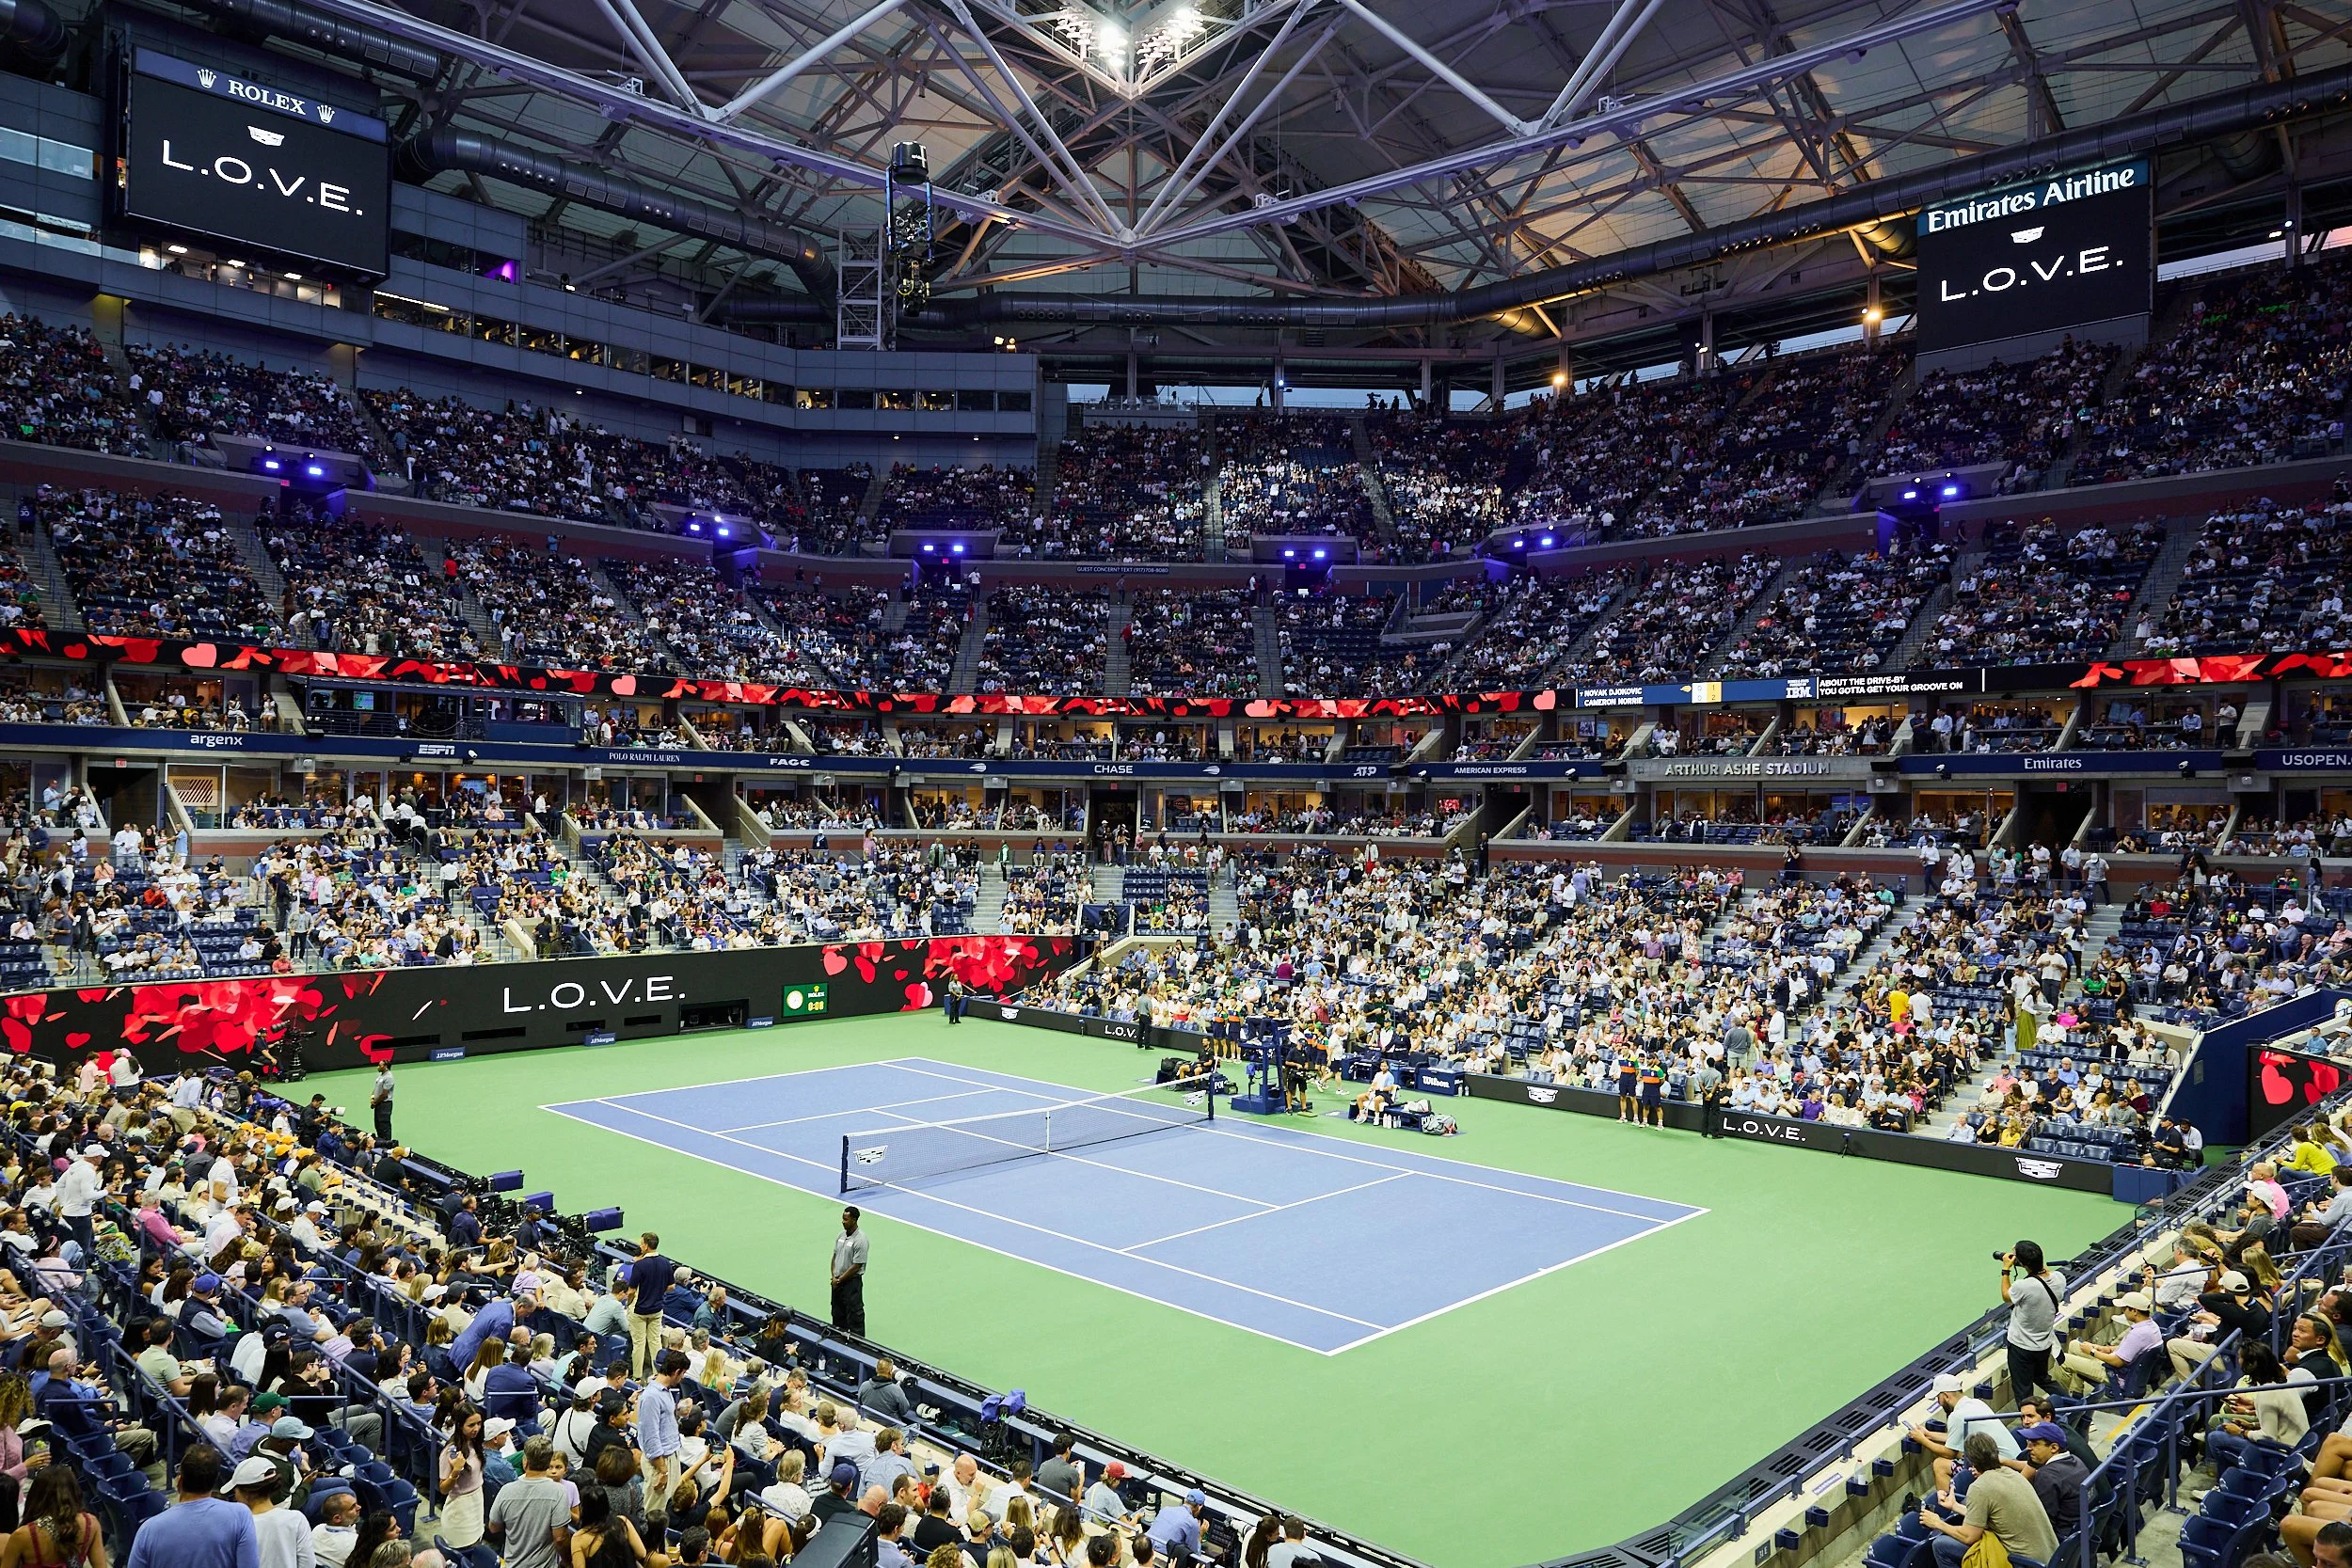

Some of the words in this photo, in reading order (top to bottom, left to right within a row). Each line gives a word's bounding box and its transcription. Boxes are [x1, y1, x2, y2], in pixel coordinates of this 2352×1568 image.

[228, 79, 307, 116] ROLEX
[162, 138, 363, 216] L.O.V.E.
[1927, 191, 2036, 234] Emirates
[2042, 168, 2135, 206] Airline
[1941, 245, 2123, 302] L.O.V.E.
[1819, 679, 1848, 688] ABOUT
[1849, 677, 1866, 686] THE
[1867, 676, 1906, 686] DRIVE-BY
[1819, 687, 1837, 695] YOU
[1837, 686, 1866, 695] GOTTA
[1867, 685, 1883, 694] GET
[1885, 684, 1910, 693] YOUR
[1910, 682, 1948, 692] GROOVE
[1948, 681, 1963, 690] ON
[1584, 689, 1608, 698] NOVAK
[1608, 687, 1643, 696] DJOKOVIC
[1786, 686, 1813, 699] IBM
[1583, 698, 1617, 706] CAMERON
[1617, 696, 1644, 705] NORRIE
[189, 734, 244, 747] argenx
[418, 744, 455, 756] ESPN
[609, 752, 628, 761] POLO
[629, 752, 652, 762] RALPH
[653, 753, 680, 763] LAUREN
[2024, 756, 2082, 769] Emirates
[2281, 754, 2352, 767] USOPEN.
[1093, 764, 1134, 774] CHASE
[1353, 766, 1377, 777] ATP
[1493, 766, 1528, 774] EXPRESS
[1664, 763, 1720, 777] ARTHUR
[1723, 763, 1761, 776] ASHE
[1765, 761, 1832, 776] STADIUM
[503, 975, 687, 1013] L.O.V.E.
[1104, 1024, 1137, 1038] L.O.V.
[1422, 1075, 1451, 1088] Wilson
[1723, 1117, 1806, 1141] L.O.V.E.
